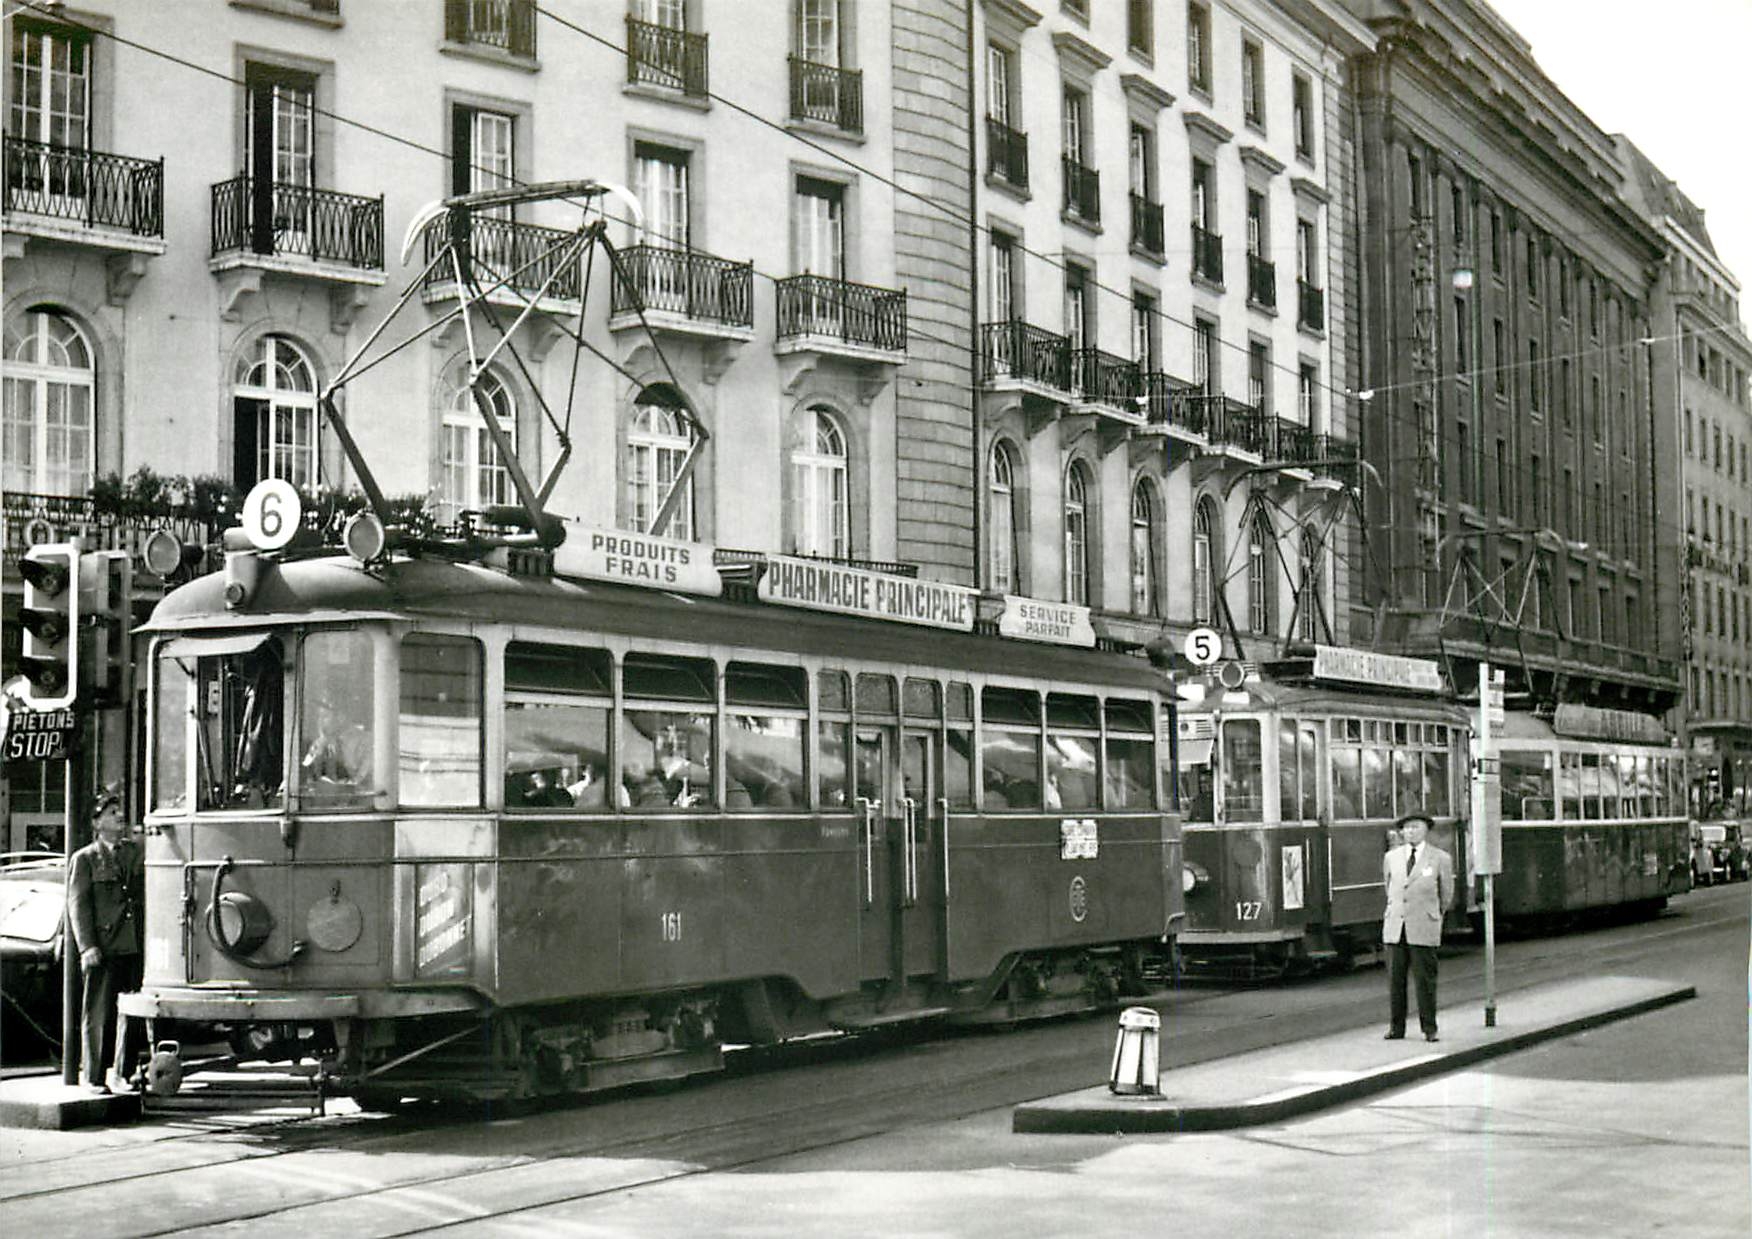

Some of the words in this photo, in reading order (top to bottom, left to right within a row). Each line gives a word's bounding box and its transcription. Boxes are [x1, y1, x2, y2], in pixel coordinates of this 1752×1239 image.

[261, 492, 282, 538] 6
[592, 534, 690, 565] PRODUITS
[606, 557, 677, 583] FRAIS
[768, 562, 869, 610] PHARMACIE
[876, 579, 967, 625] PRINCIPALE
[1020, 604, 1077, 625] SERVICE
[1025, 621, 1071, 639] PARFAIT
[1195, 635, 1210, 661] 5
[13, 710, 75, 731] PIETONS
[11, 731, 60, 758] STOP
[1236, 902, 1262, 921] 127
[662, 912, 681, 941] 161
